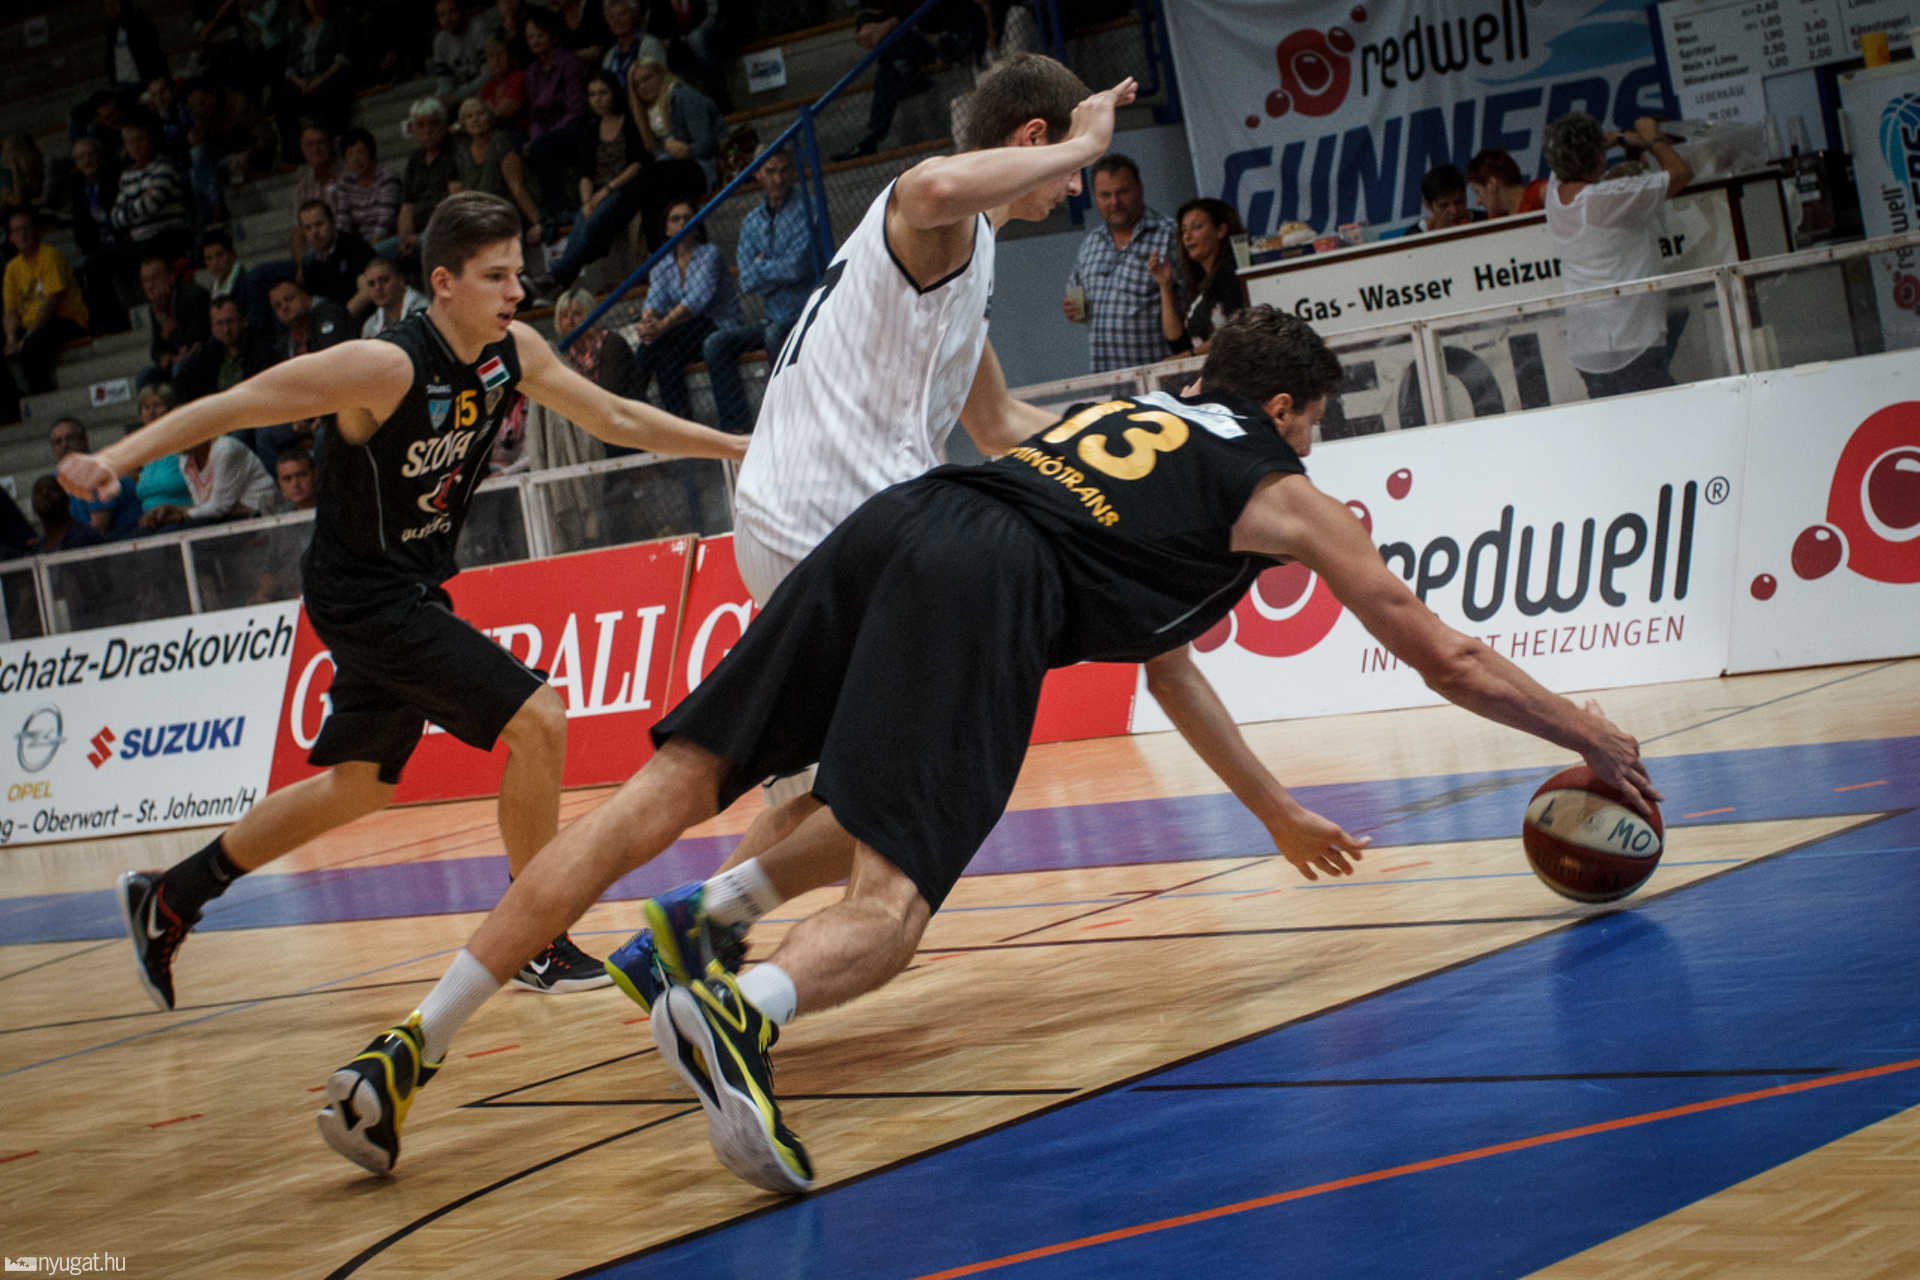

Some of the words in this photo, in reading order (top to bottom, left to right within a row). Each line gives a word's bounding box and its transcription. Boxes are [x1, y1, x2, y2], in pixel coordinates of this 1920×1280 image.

[1361, 0, 1531, 97] redwell
[1882, 186, 1917, 270] rewell
[1295, 296, 1343, 323] Gas
[1359, 275, 1453, 313] Wasser
[454, 389, 479, 430] 15
[1042, 400, 1190, 481] 13
[1379, 480, 1698, 622] redwell
[0, 613, 294, 694] chatz-Draskovich
[1511, 615, 1686, 658] HEIZUNGEN
[119, 715, 247, 761] SUZUKI
[7, 781, 54, 803] OPEL
[33, 803, 121, 834] Oberwart
[137, 799, 159, 824] St.
[1607, 816, 1653, 852] MO
